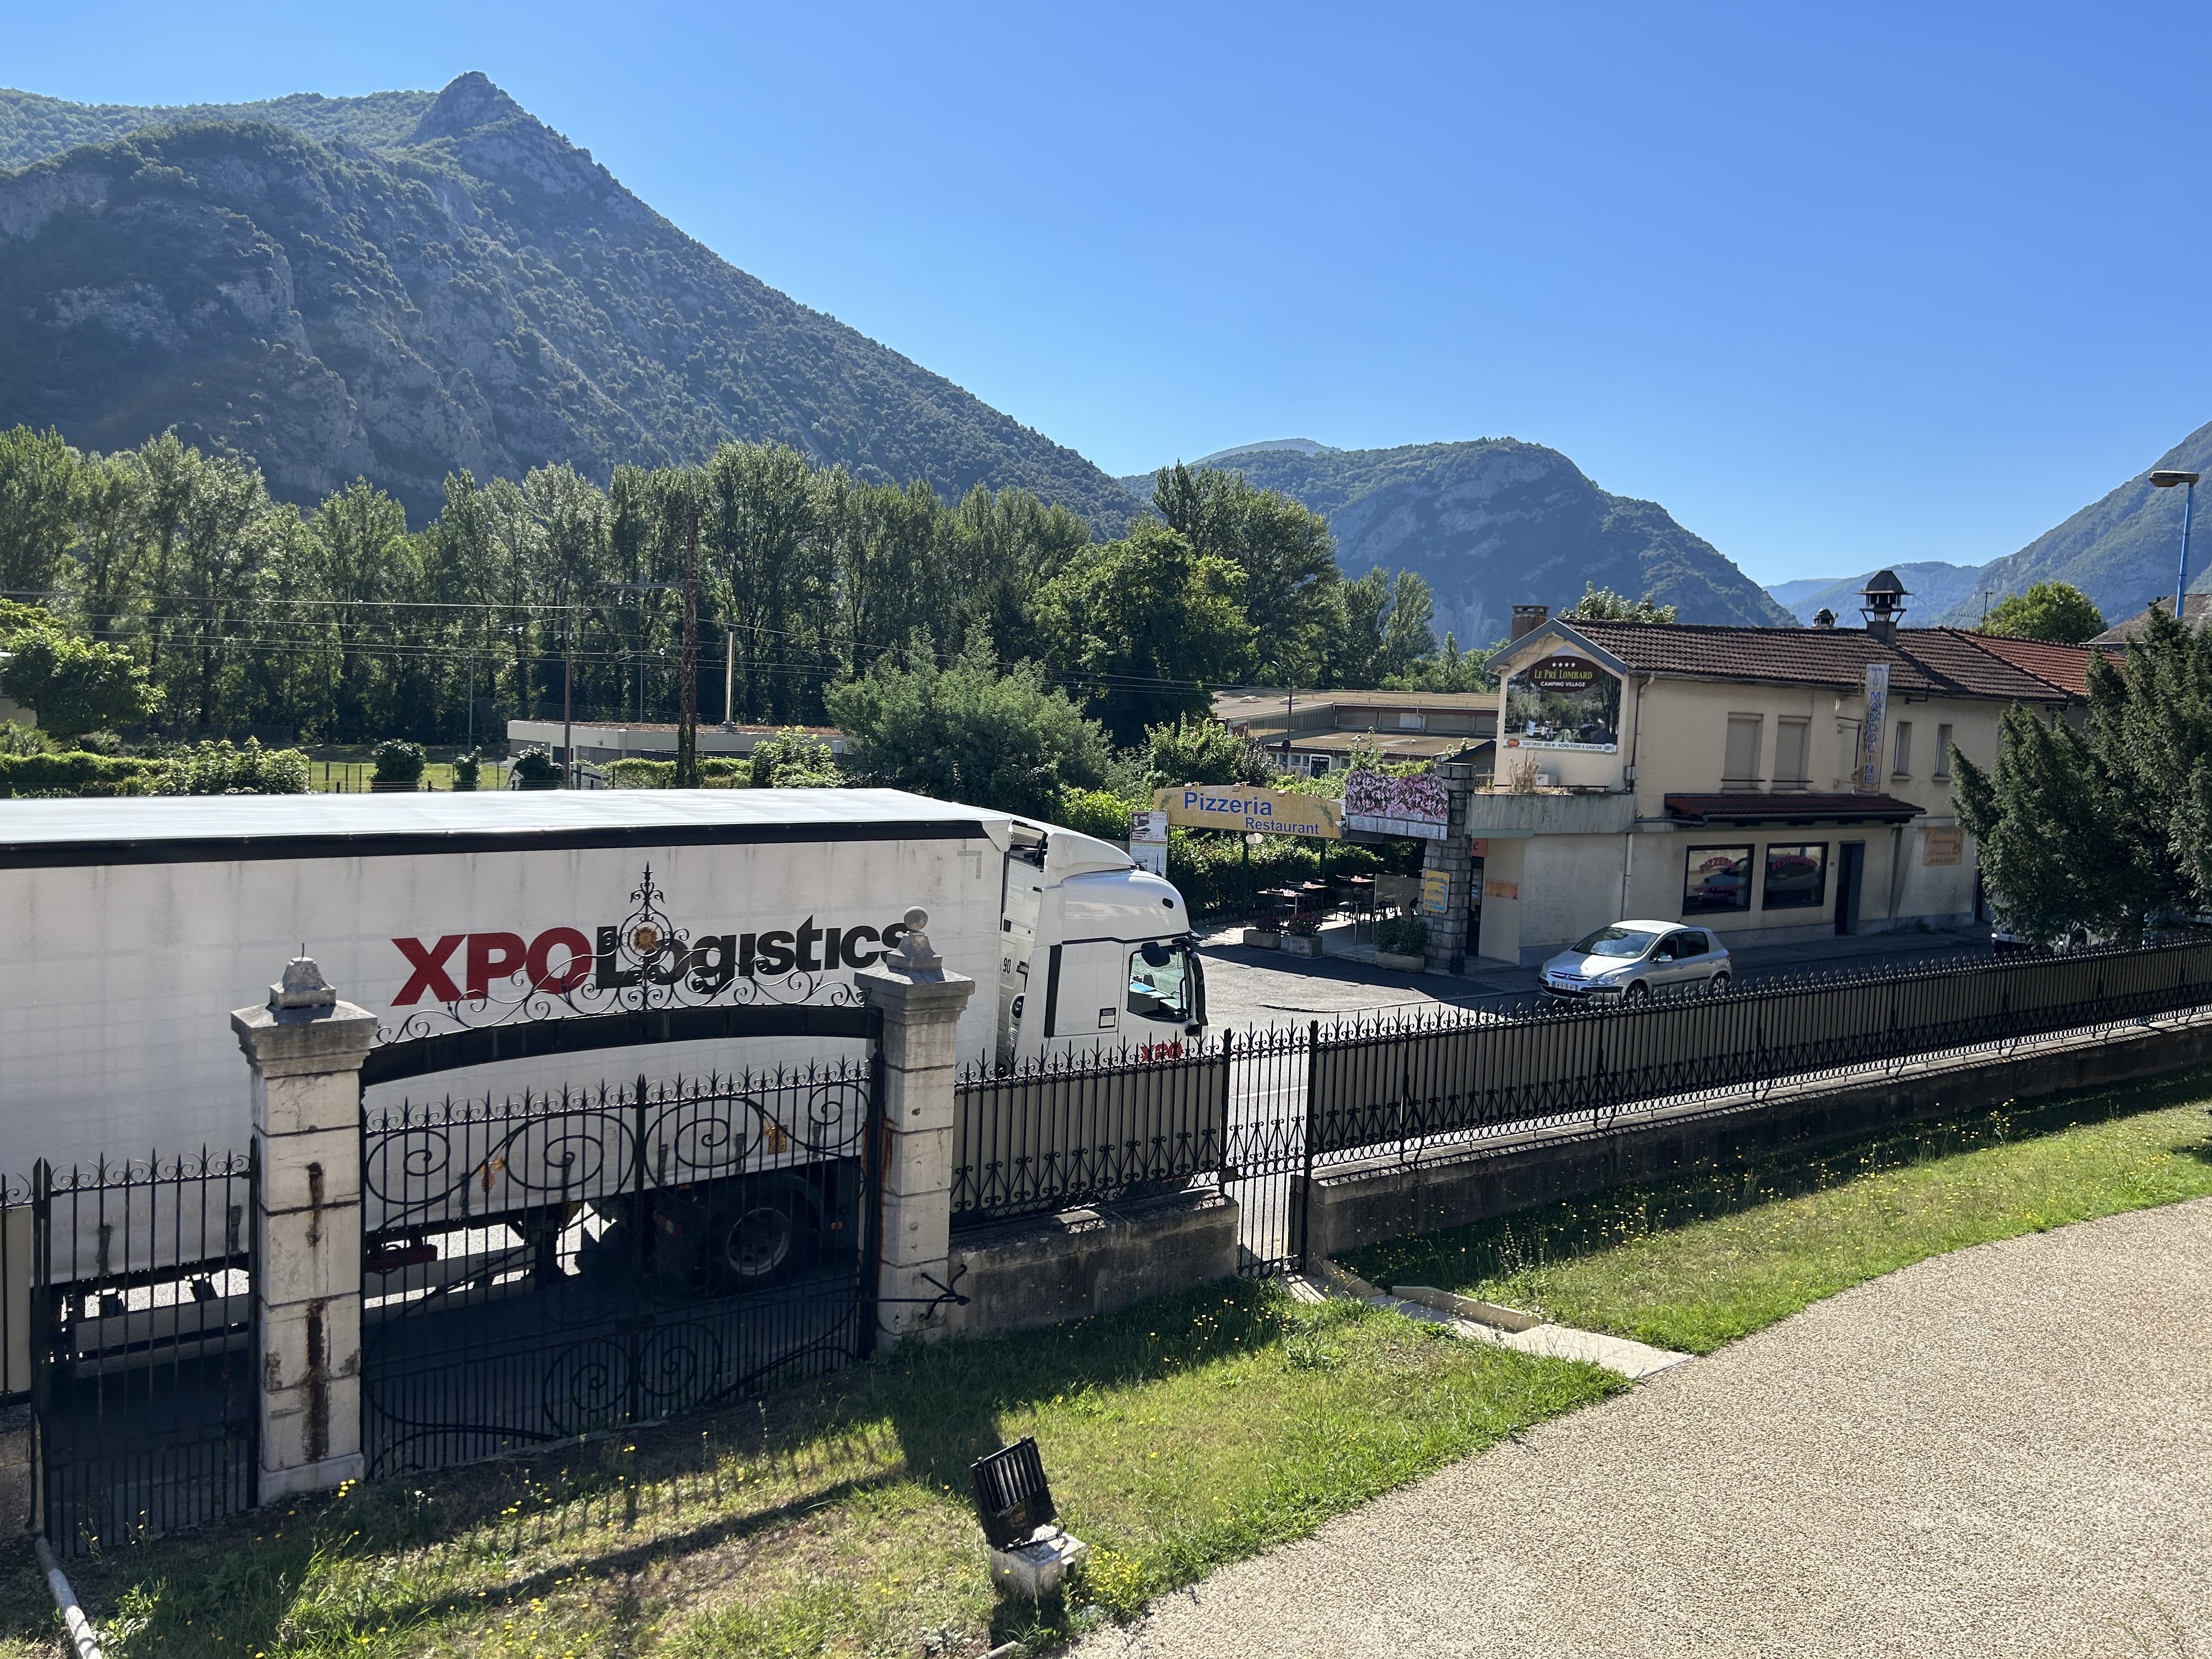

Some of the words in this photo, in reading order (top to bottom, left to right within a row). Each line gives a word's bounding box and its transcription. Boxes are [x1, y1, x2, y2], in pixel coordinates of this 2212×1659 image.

[1559, 669, 1593, 680] LOMBARD
[1864, 691, 1881, 785] MANDOLINE
[1184, 791, 1272, 816] Pizzeria
[1245, 817, 1320, 835] Restaurant
[1003, 957, 1011, 974] 90
